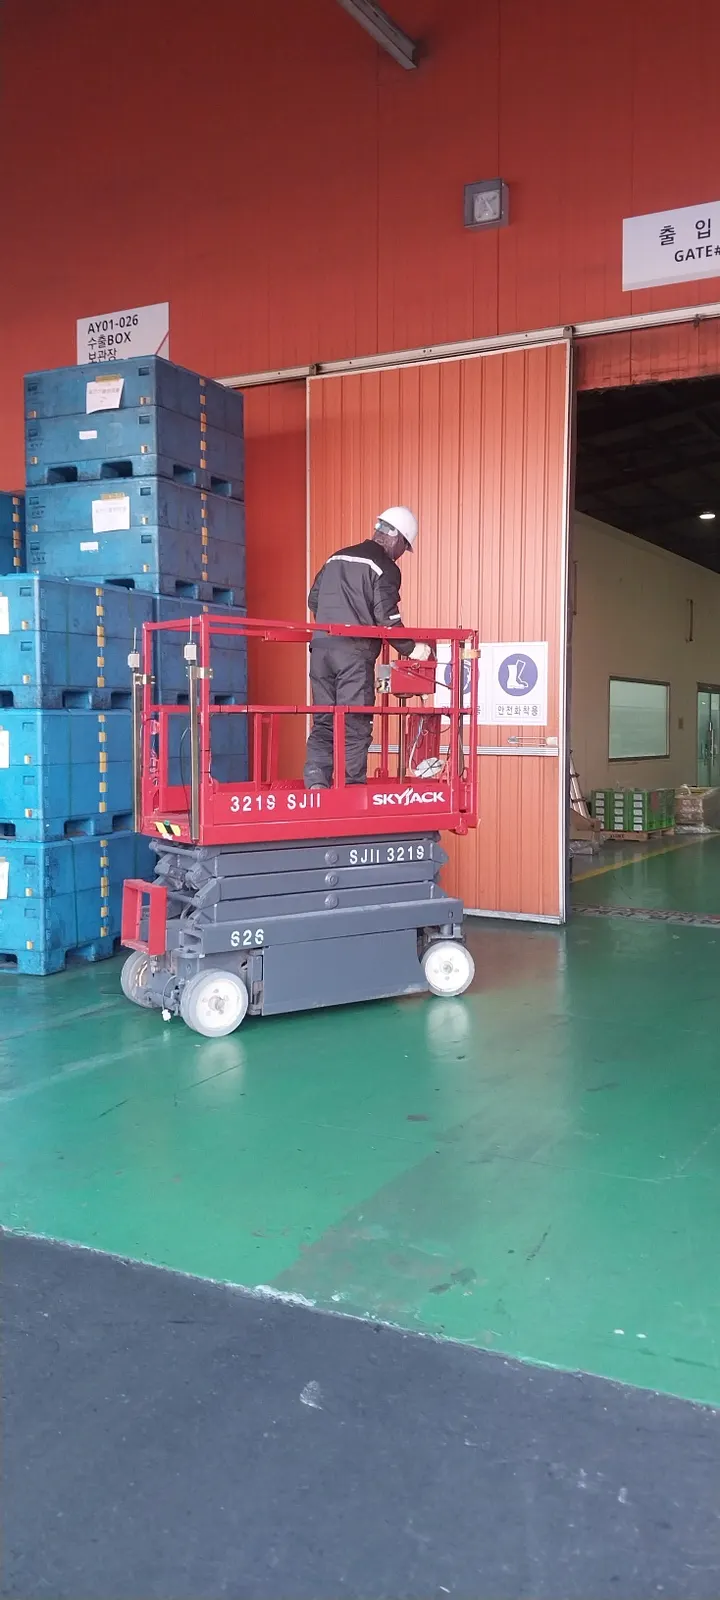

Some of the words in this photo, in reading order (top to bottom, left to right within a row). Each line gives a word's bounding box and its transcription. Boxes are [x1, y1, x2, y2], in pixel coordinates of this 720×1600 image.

[87, 314, 139, 335] AY01-026
[87, 331, 132, 350] 수출BOX
[230, 794, 276, 813] 3219
[372, 787, 446, 806] SKYJACK
[387, 845, 425, 862] 3219
